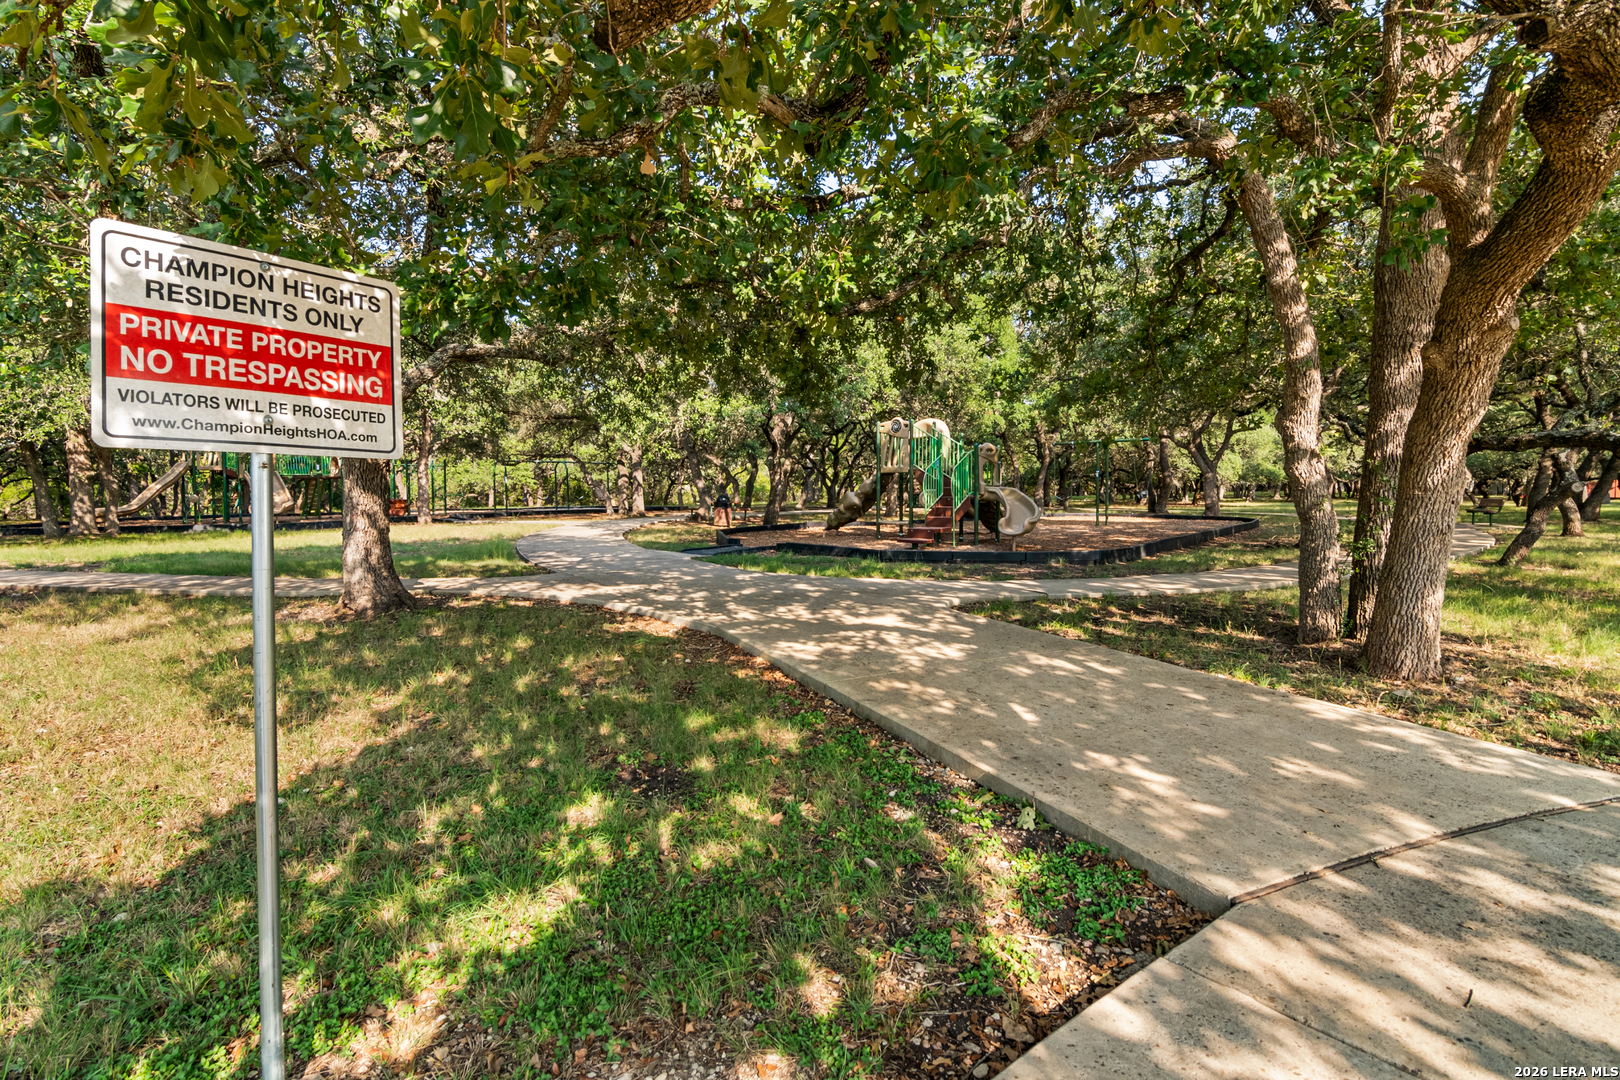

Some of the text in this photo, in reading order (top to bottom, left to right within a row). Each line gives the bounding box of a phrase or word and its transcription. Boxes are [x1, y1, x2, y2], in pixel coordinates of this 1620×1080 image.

[120, 246, 381, 313] CHAMPION HEIGHTS
[145, 278, 364, 334] RESIDENTS ONLY
[119, 312, 382, 369] PRIVATE PROPERTY
[120, 344, 384, 398] NO TRESPASSING
[117, 388, 386, 424] VIOLATORS WILL BE PROSECUTED
[132, 416, 378, 443] www.ChampionHeightsHOA.com
